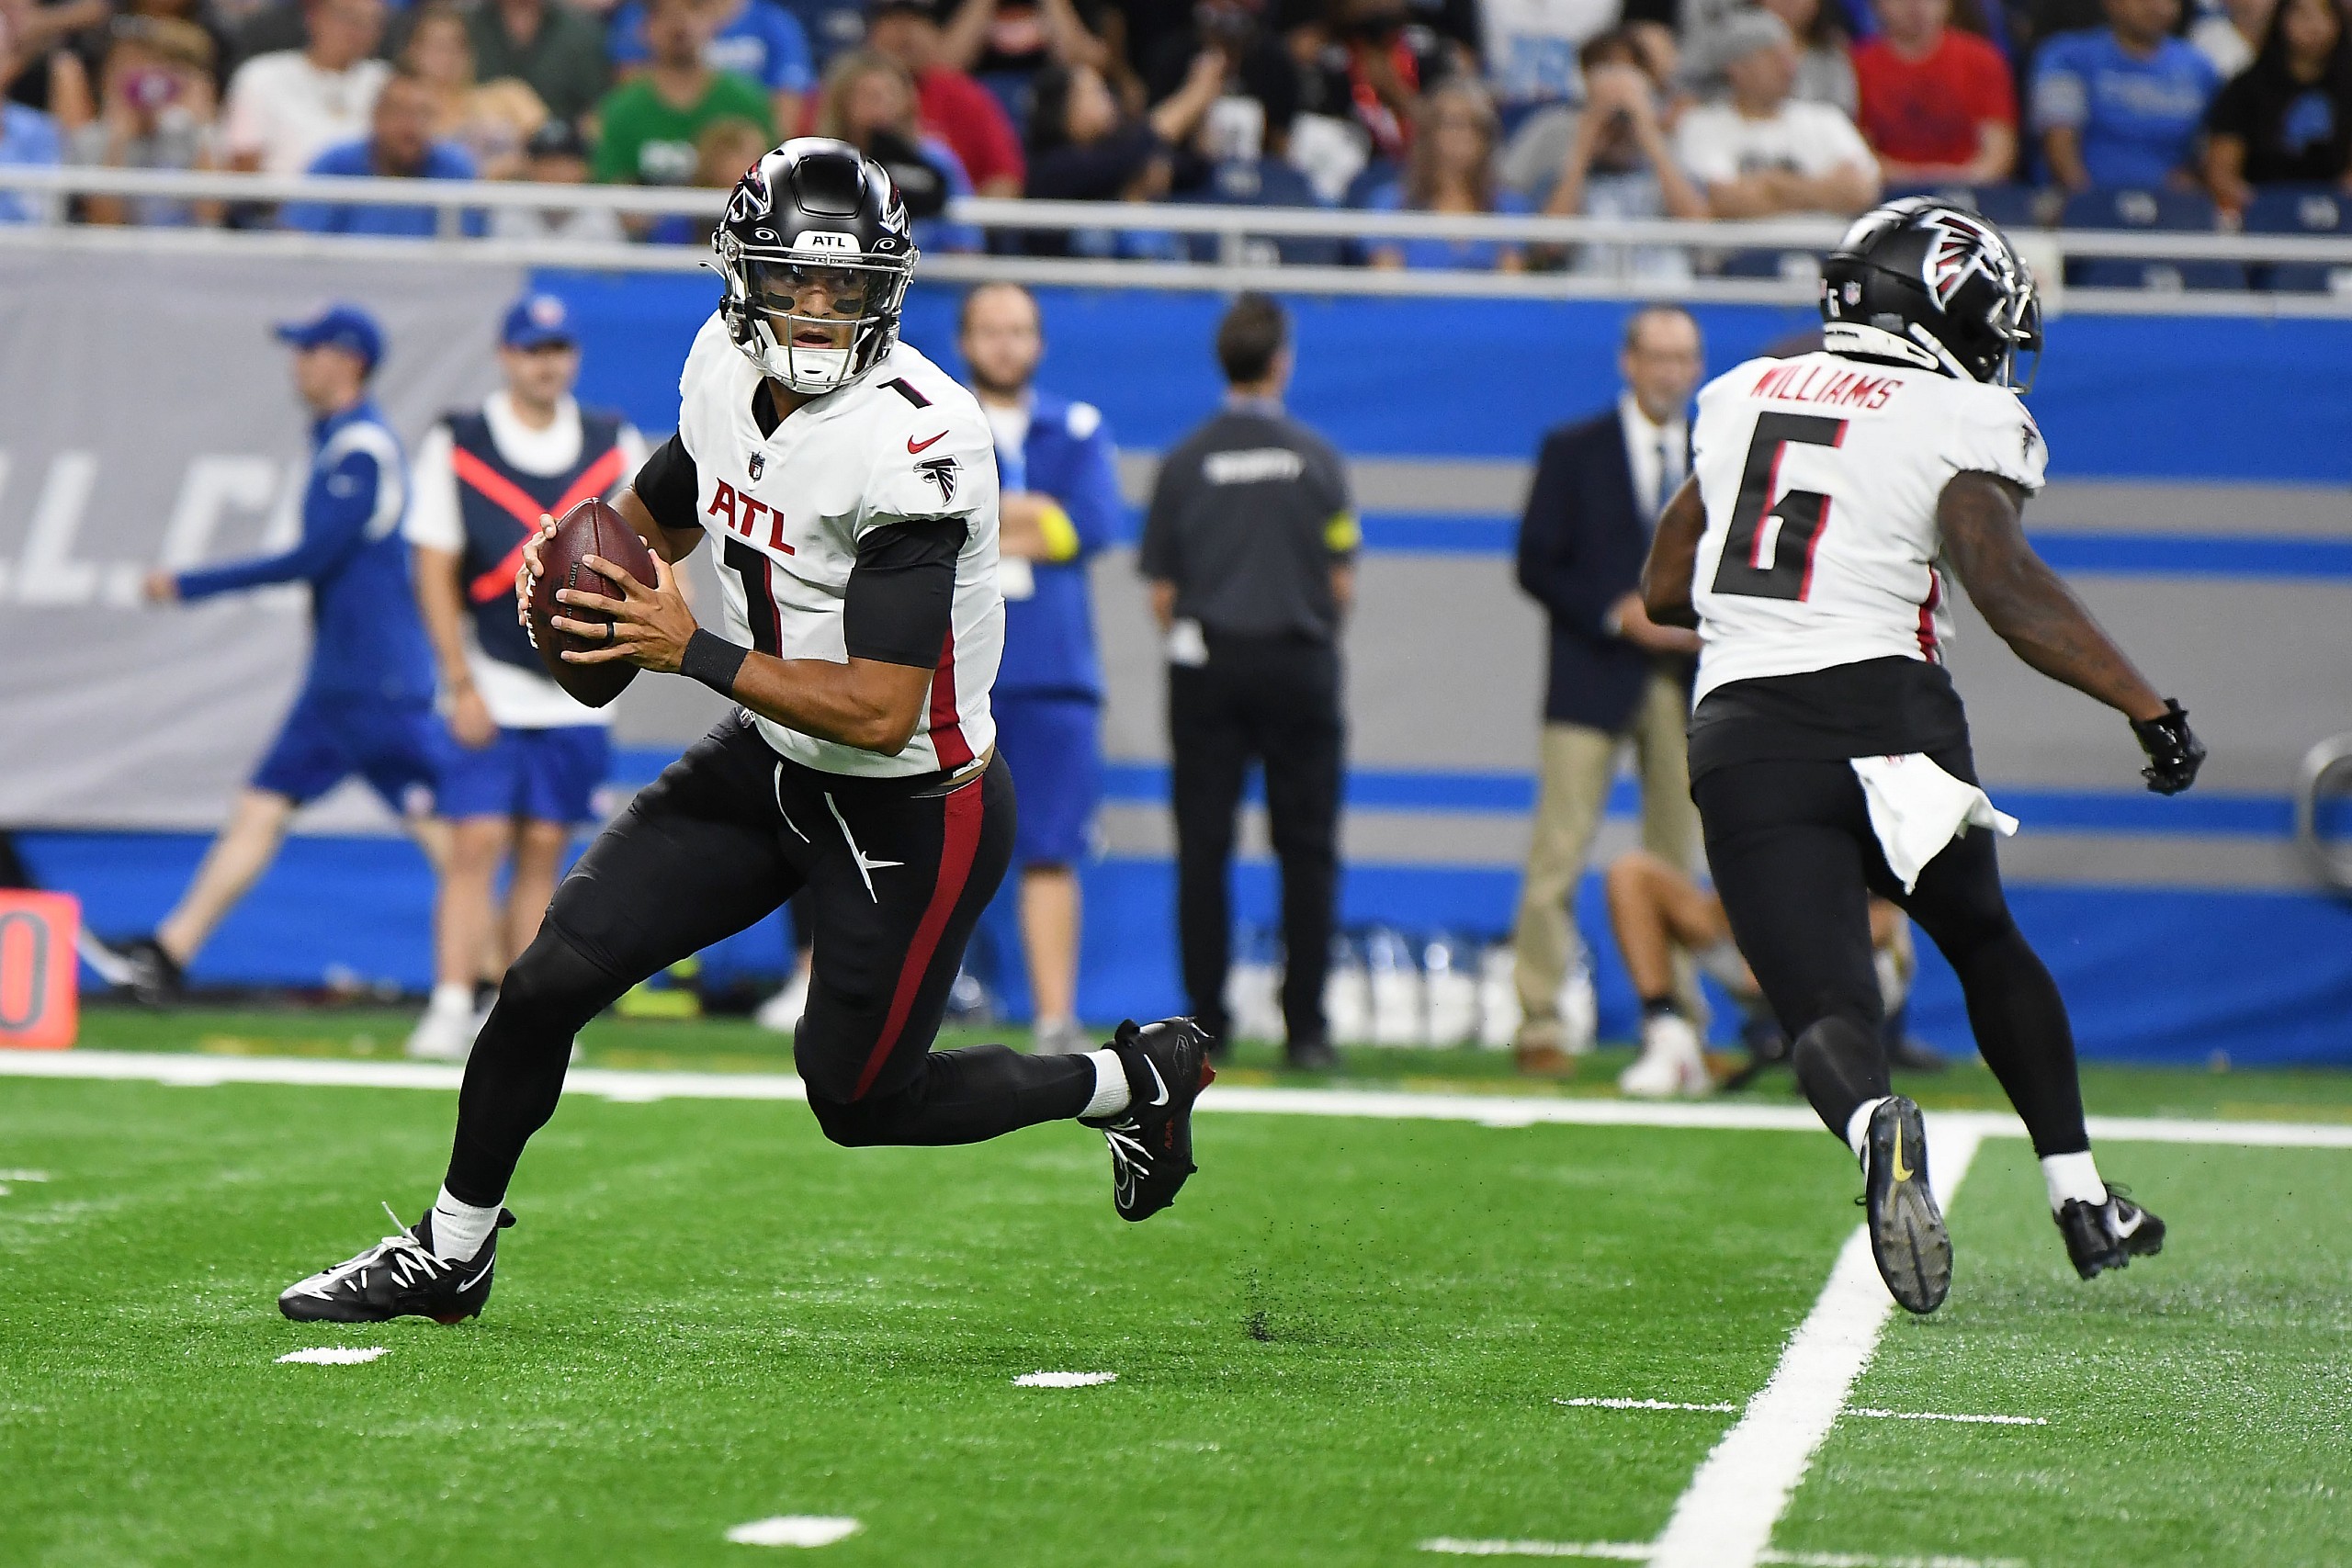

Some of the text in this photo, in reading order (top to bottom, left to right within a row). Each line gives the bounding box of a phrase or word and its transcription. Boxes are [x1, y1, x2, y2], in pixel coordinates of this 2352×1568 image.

[812, 235, 846, 248] ATL
[876, 377, 934, 409] 1
[1750, 365, 1904, 409] WILLIAMS
[707, 477, 795, 556] ATL
[1712, 411, 1849, 603] 6
[723, 535, 783, 660] 1
[0, 910, 50, 1033] 0
